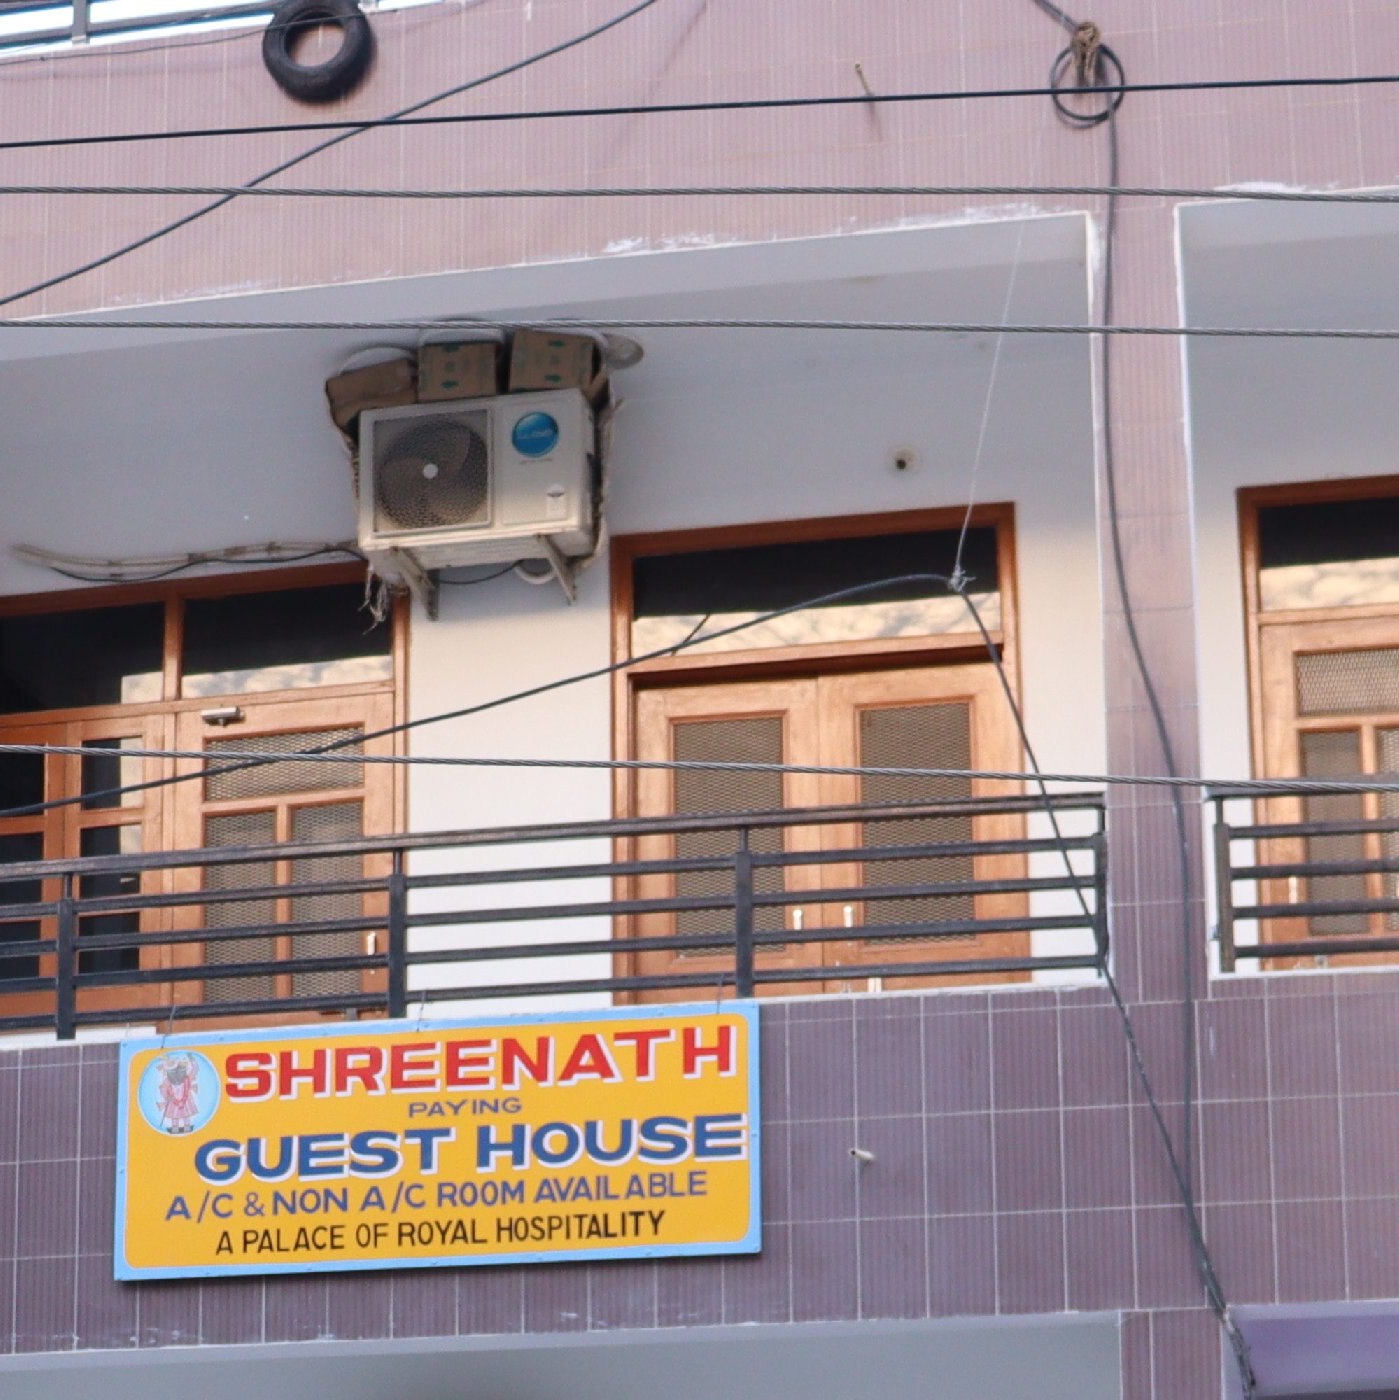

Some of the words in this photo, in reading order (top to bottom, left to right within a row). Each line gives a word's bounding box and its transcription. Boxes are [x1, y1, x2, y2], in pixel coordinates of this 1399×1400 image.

[225, 1024, 737, 1103] SHREENATH
[408, 1096, 522, 1118] PAYING
[194, 1126, 456, 1185] GUEST
[476, 1113, 748, 1173] HOUSE
[272, 1187, 348, 1216] NON
[436, 1179, 525, 1208] ROOM
[533, 1170, 708, 1204] AVAILABLE
[215, 1230, 234, 1256] A
[242, 1224, 346, 1254] PALACE
[355, 1221, 389, 1249] OF
[397, 1218, 488, 1247] ROYAL
[495, 1209, 666, 1243] HOSPITALITY
